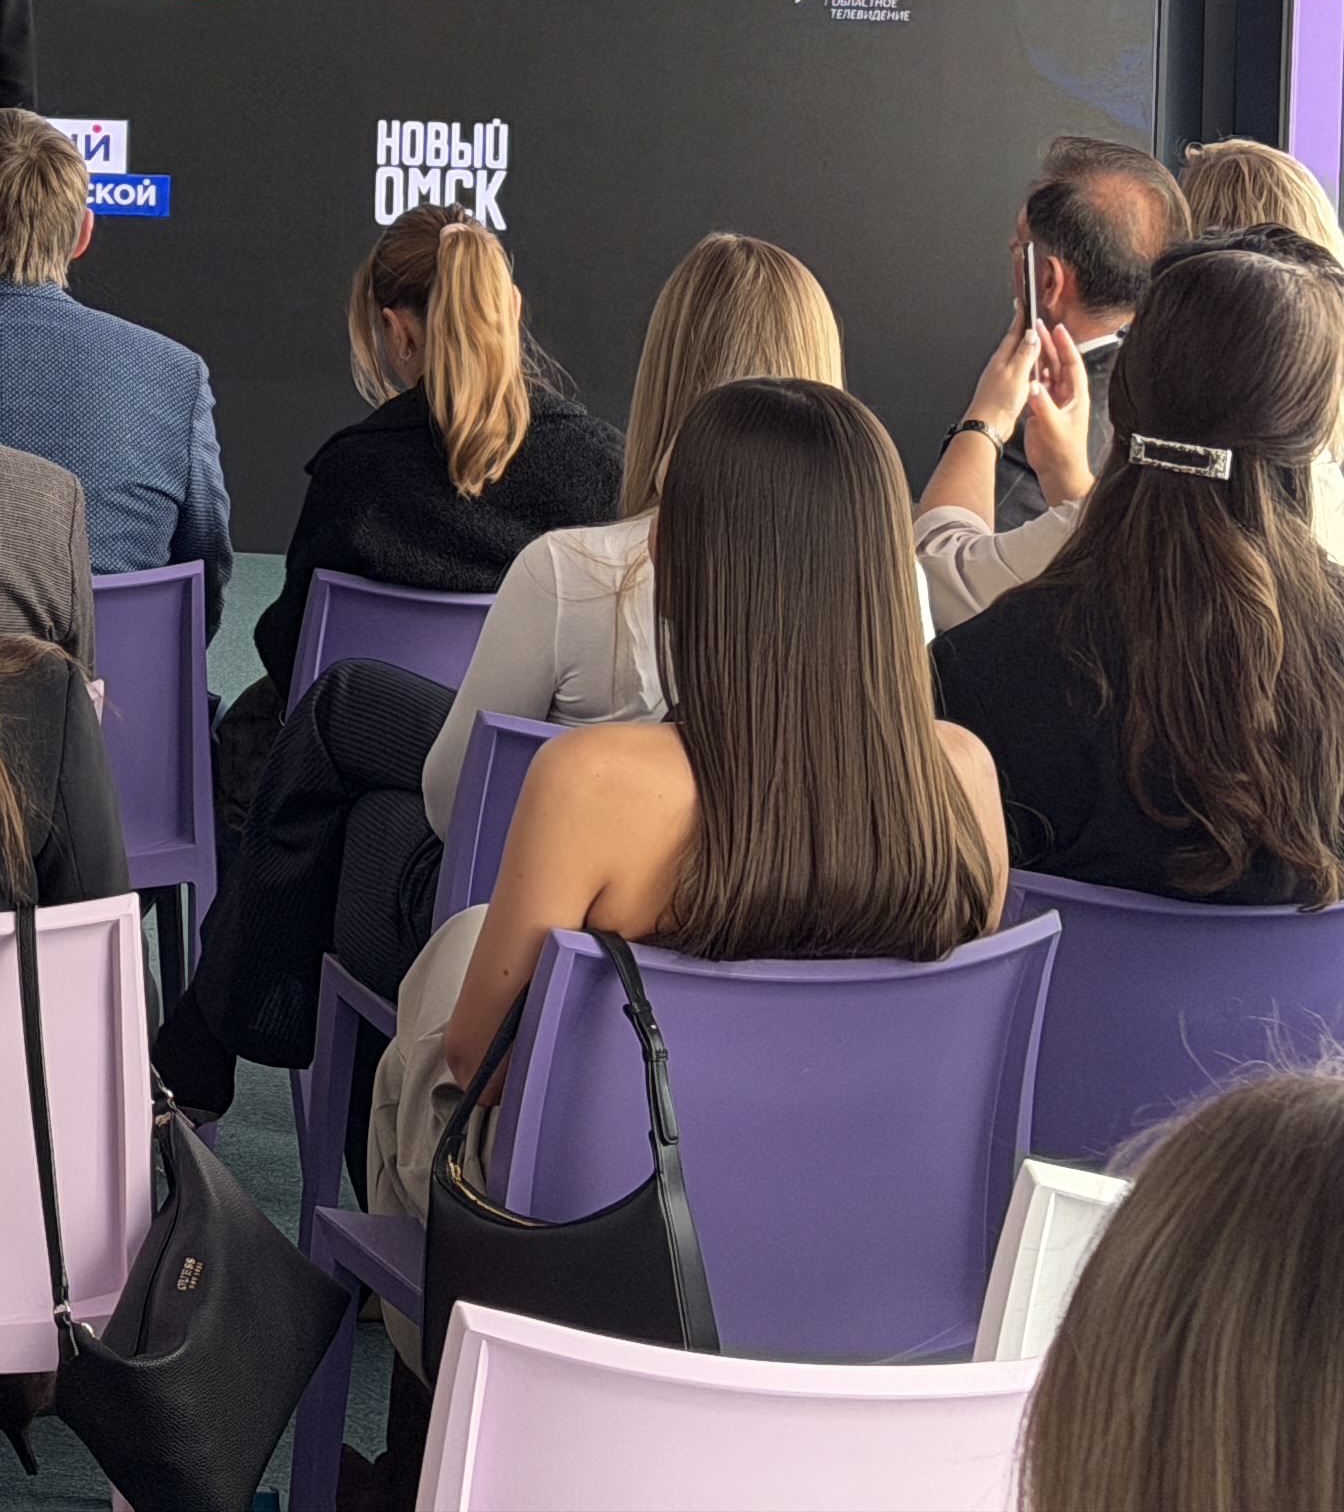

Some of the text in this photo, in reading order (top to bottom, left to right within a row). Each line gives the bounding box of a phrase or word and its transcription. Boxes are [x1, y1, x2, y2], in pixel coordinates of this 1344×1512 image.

[830, 8, 911, 21] ТЕЛЕВИДЕНИЕ
[376, 118, 509, 169] НОВЫЙ
[374, 166, 508, 230] ОМСК
